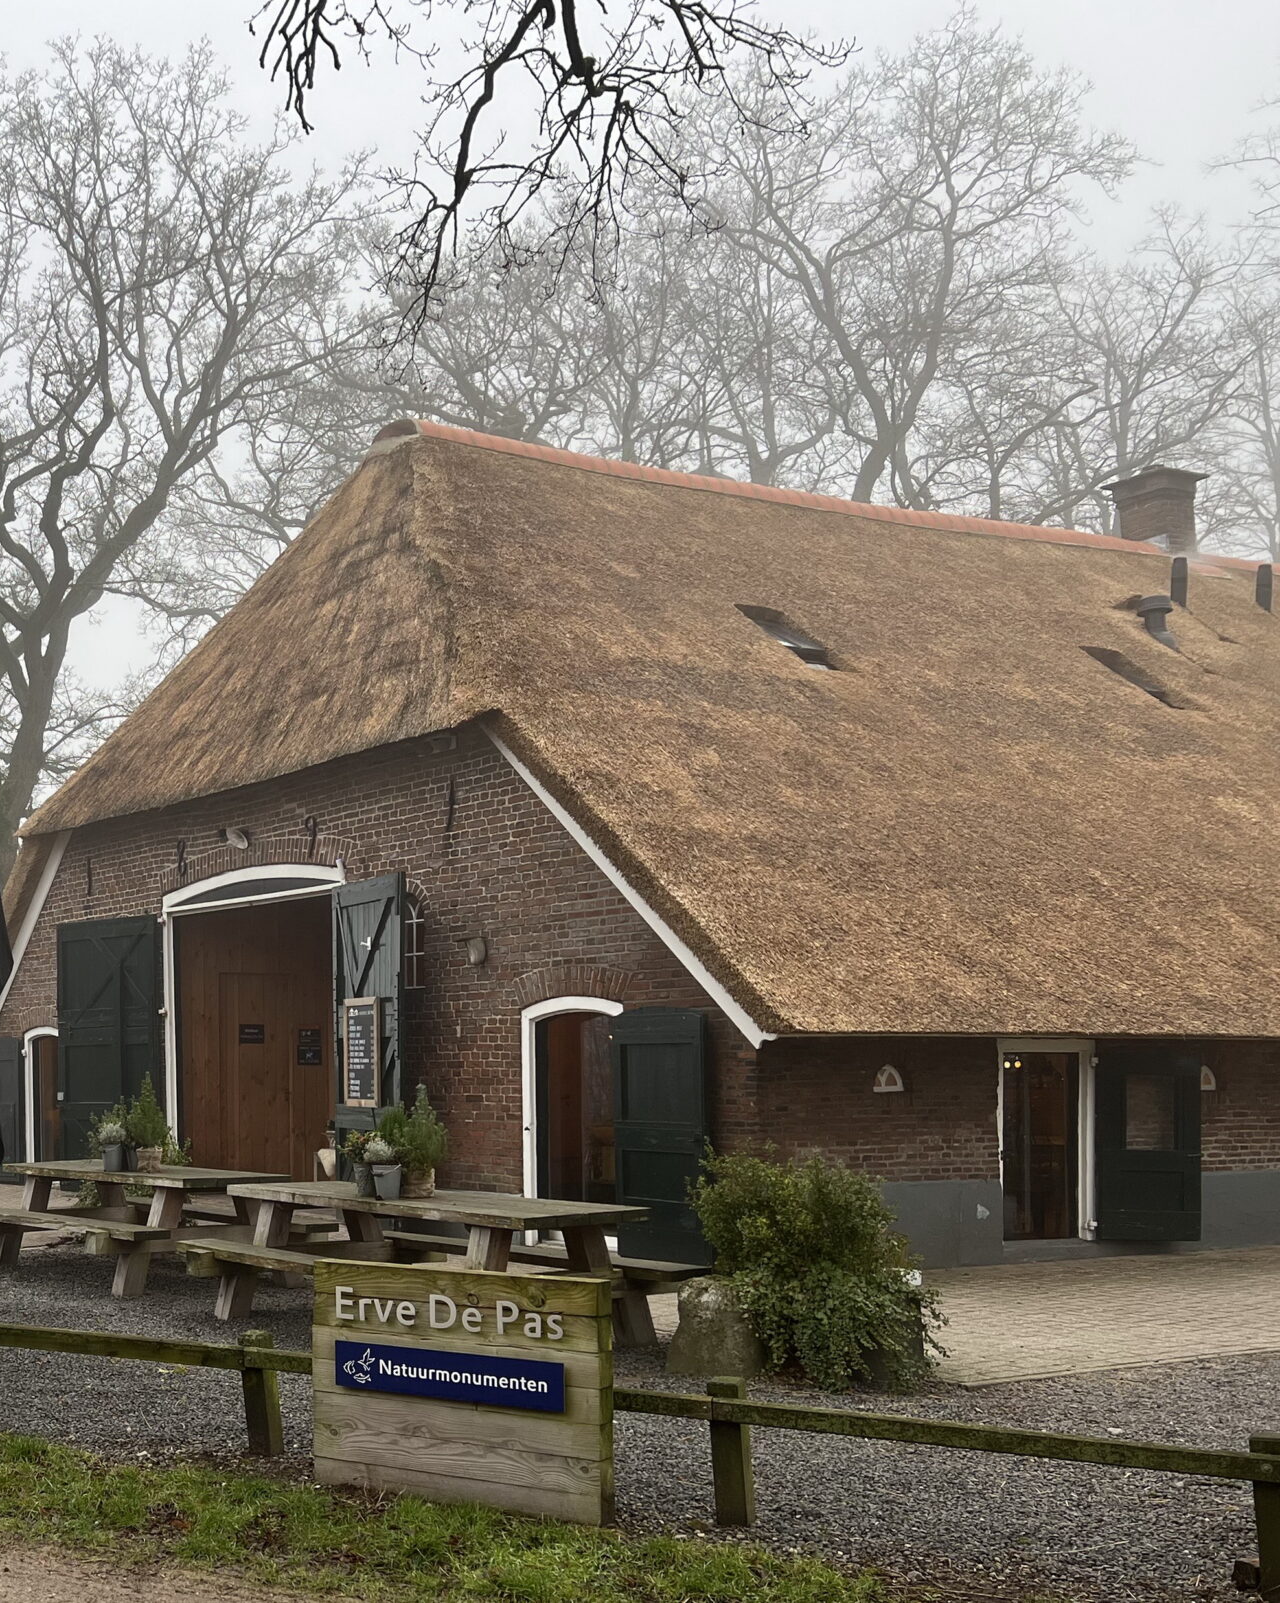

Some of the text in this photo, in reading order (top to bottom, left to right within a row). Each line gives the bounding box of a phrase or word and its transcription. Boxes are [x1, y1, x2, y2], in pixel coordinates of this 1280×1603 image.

[335, 1286, 564, 1340] Erve De Pas
[379, 1359, 548, 1393] Natuurmonumenten
